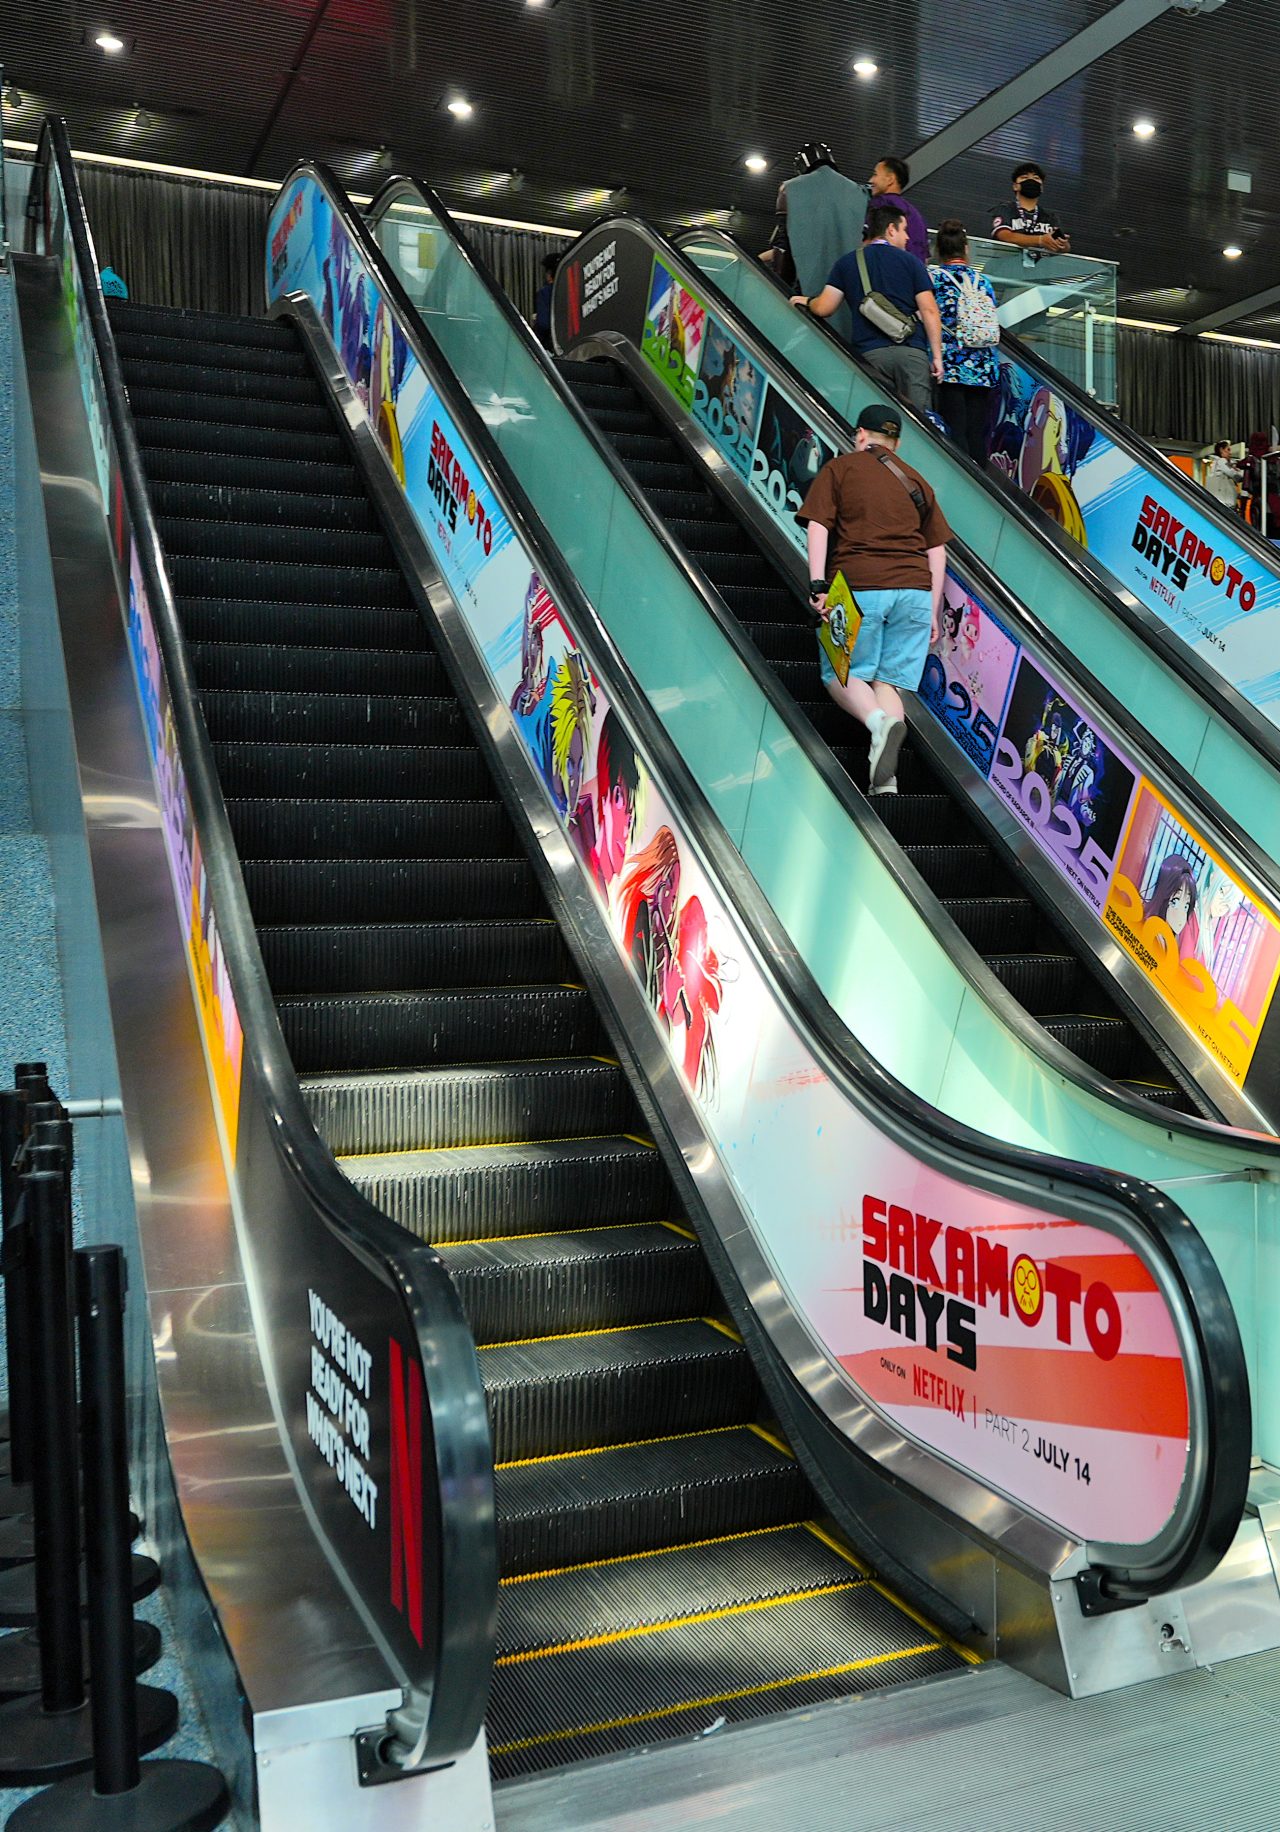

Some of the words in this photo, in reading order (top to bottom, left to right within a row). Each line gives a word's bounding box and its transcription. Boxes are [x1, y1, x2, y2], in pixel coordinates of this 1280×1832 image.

[602, 261, 615, 283] FOR
[602, 277, 619, 301] NEXT
[603, 240, 616, 262] NOT
[692, 379, 754, 465] 2025
[427, 454, 458, 534] DAYS
[430, 420, 492, 556] SAKAMOTO
[1132, 522, 1190, 591] DAYS
[1139, 495, 1256, 611] SAKAMOTO
[1149, 576, 1176, 609] NETFLIX
[990, 733, 1112, 893] 2025
[1104, 873, 1257, 1050] 2025
[1105, 912, 1123, 936] BLOOMS
[1123, 934, 1135, 951] WITH
[1134, 948, 1153, 972] DIGNITY
[1108, 905, 1117, 918] THE
[1116, 916, 1139, 946] FRAGRANT
[1138, 944, 1158, 969] FLOWER
[862, 1194, 1122, 1362] SAKAMOTO
[863, 1259, 976, 1372] DAYS
[309, 1288, 346, 1370] YOU'RE
[346, 1331, 373, 1399] NOT
[311, 1345, 345, 1424] READY
[345, 1389, 370, 1461] FOR
[880, 1356, 897, 1375] ONLY
[896, 1366, 906, 1379] ON
[913, 1364, 965, 1422] NETFLIX
[985, 1408, 1018, 1445] PART
[1021, 1428, 1030, 1453] 2
[1033, 1437, 1070, 1473] JULY
[1074, 1458, 1091, 1486] 14
[306, 1391, 345, 1485] WHAT'S
[345, 1447, 377, 1530] NEXT
